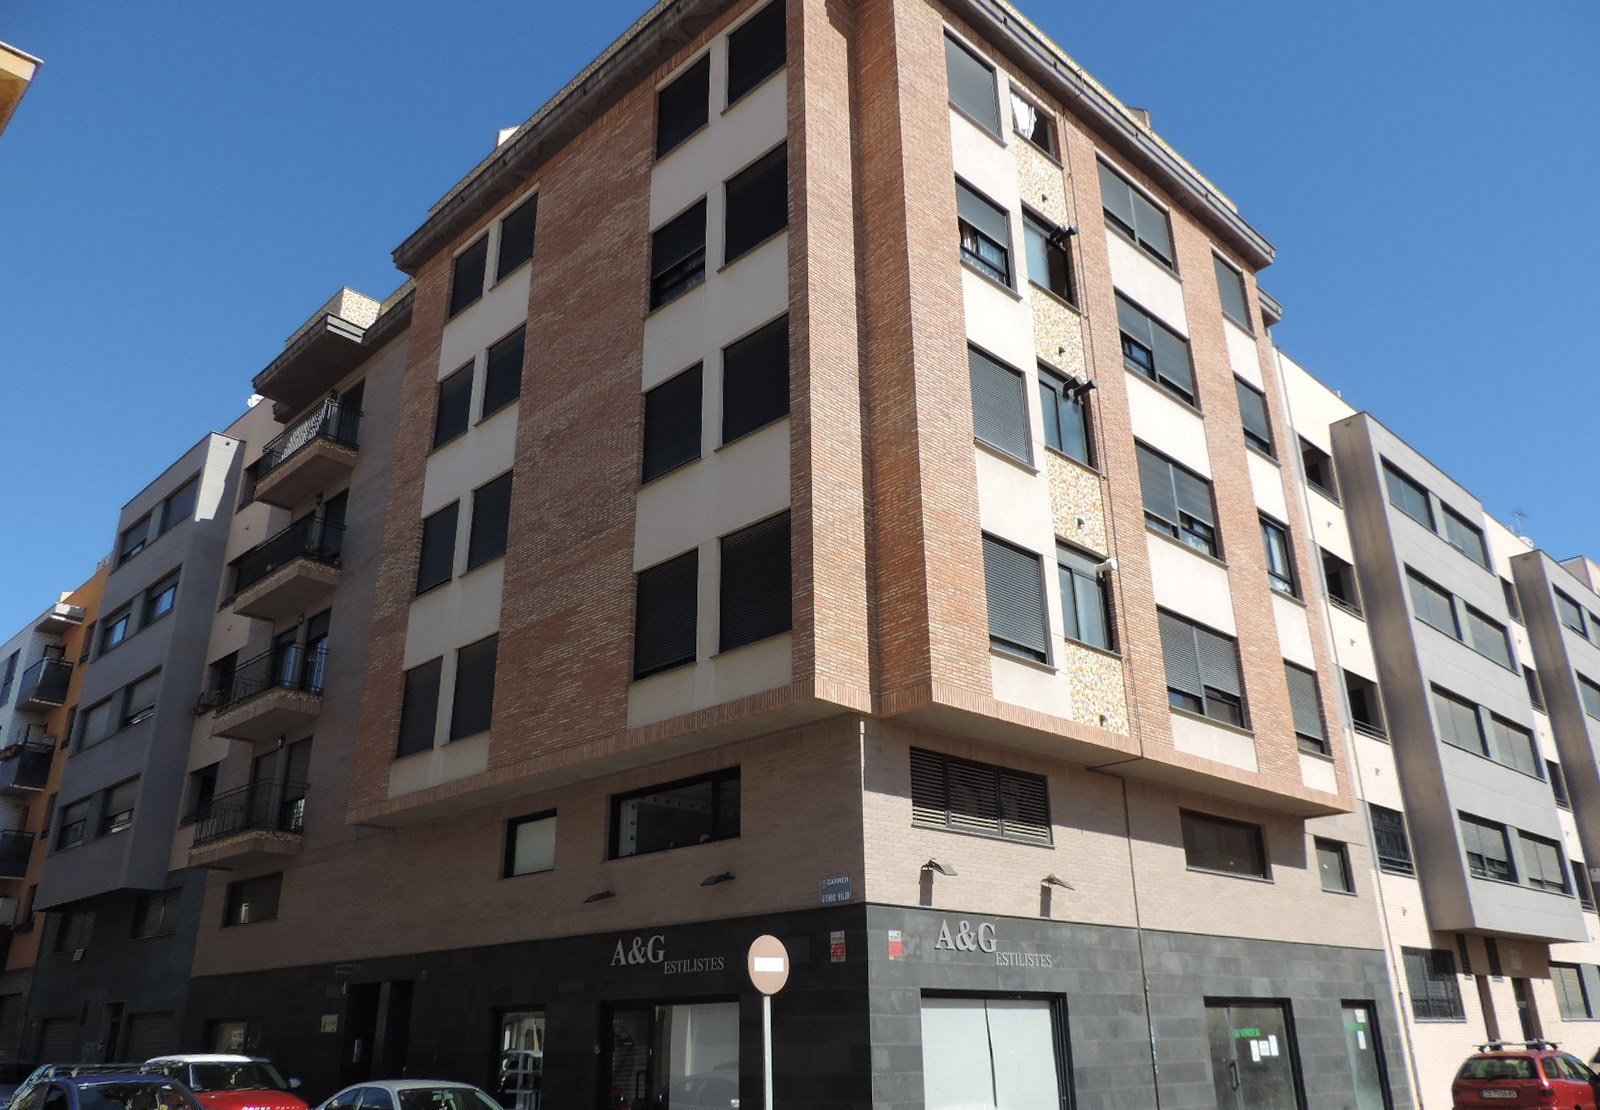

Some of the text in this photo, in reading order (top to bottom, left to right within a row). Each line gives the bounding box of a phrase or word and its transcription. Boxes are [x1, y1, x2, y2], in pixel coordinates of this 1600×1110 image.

[827, 876, 849, 886] CARRER
[610, 935, 725, 975] A&G ESTILISTES
[934, 919, 1053, 968] A&G ESTILISTES
